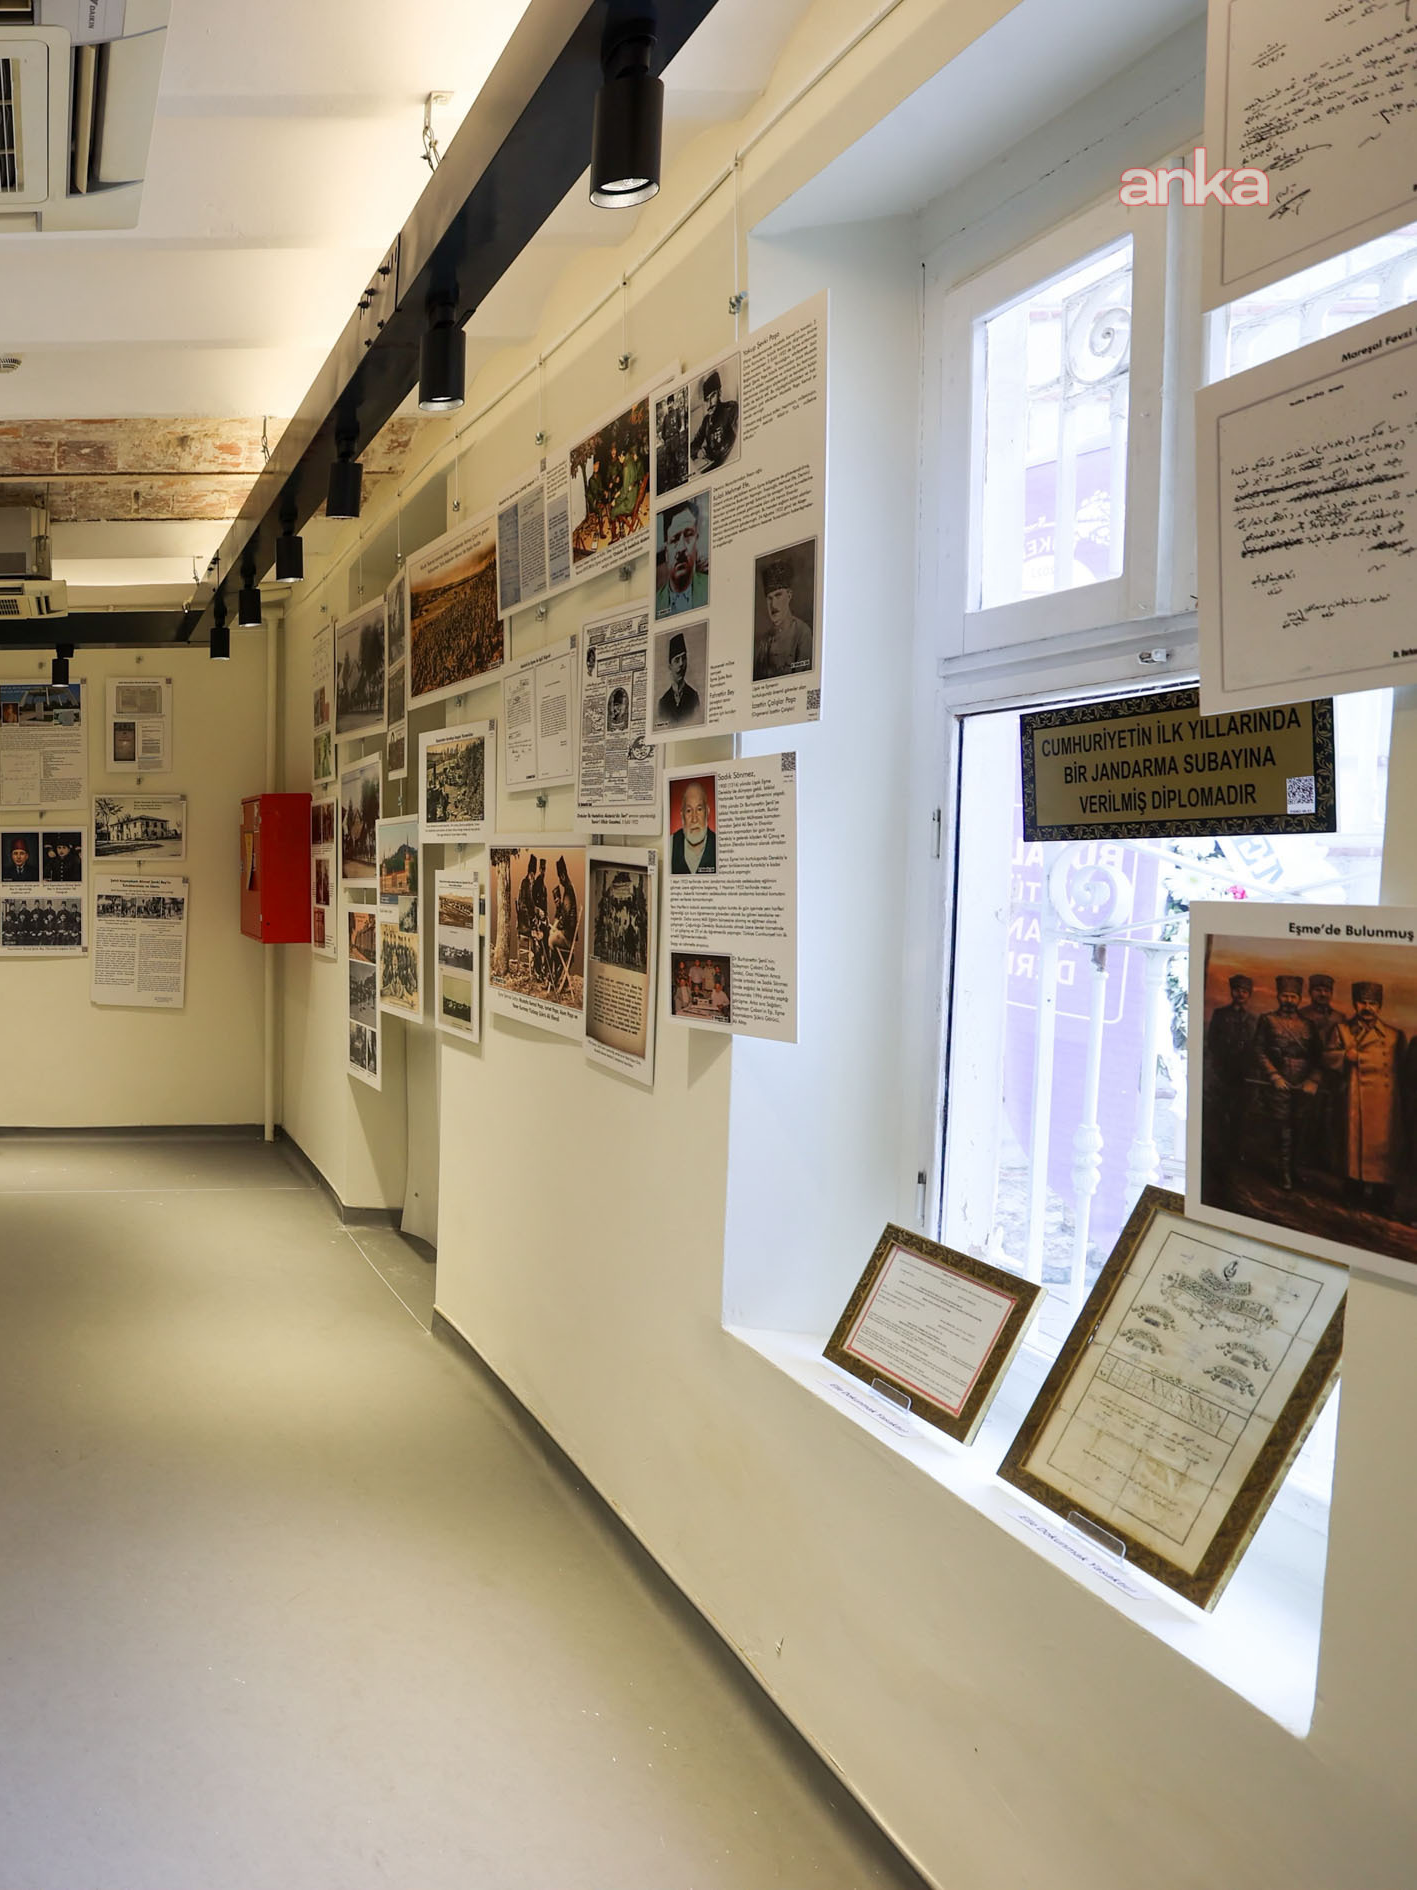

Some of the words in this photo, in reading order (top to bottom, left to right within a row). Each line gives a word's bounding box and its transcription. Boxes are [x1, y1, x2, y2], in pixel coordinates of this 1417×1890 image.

[1342, 339, 1382, 362] Mareşal
[1385, 327, 1412, 345] Fevzi
[1041, 722, 1152, 757] CUMHURİYETİN
[1157, 719, 1184, 744] İLK
[1188, 707, 1301, 740] YILLARINDA
[1063, 762, 1088, 784] BİR
[1091, 756, 1179, 782] JANDARMA
[1183, 745, 1277, 773] SUBAYINA
[1079, 786, 1147, 816] VERİLMİŞ
[1153, 783, 1257, 811] DİPLOMADIR
[1288, 922, 1341, 937] Eşme'de
[1345, 925, 1415, 942] Bulunmuş
